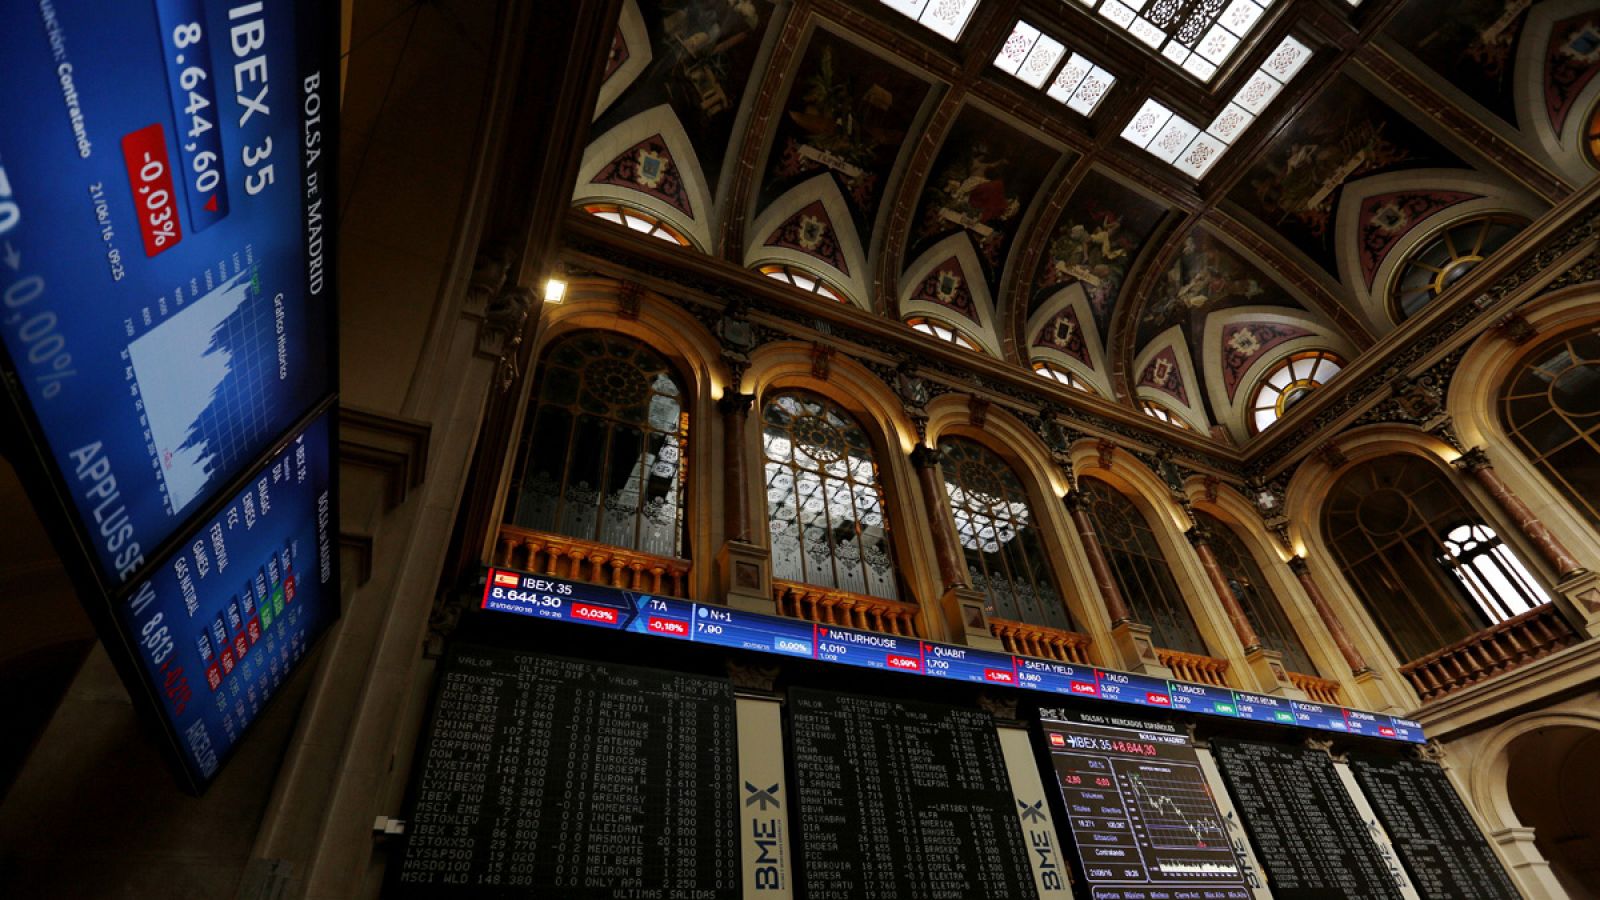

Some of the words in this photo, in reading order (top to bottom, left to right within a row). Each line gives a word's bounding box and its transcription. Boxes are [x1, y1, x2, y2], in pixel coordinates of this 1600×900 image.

[228, 1, 270, 129] IBEX
[57, 62, 92, 159] Contratando
[173, 21, 220, 193] 8.644,60
[303, 71, 321, 168] BOLSA
[242, 135, 275, 196] 35
[306, 171, 319, 199] DE
[140, 152, 176, 247] -0,03%
[89, 182, 112, 241] 21/06/16
[107, 248, 126, 282] 09:25
[307, 198, 323, 295] MADRID
[273, 292, 285, 335] Gráfico
[3, 274, 77, 400] 0,00%
[276, 334, 289, 381] Histórico
[271, 463, 283, 484] DIA
[257, 476, 272, 517] ENAGAS
[241, 490, 257, 531] ENDESA
[226, 506, 240, 531] FCC
[68, 439, 134, 556] APPLUS
[140, 610, 174, 665] 8,613
[208, 521, 230, 575] FERROVIAL
[191, 538, 210, 580] GAMESA
[173, 555, 189, 581] GAS
[522, 577, 554, 592] IBEX
[556, 583, 573, 595] 35
[179, 573, 200, 618] NATURAL
[492, 587, 561, 608] 8.644,30
[649, 599, 668, 612] TA
[575, 607, 613, 621] -0,03%
[710, 609, 733, 622] N+1
[650, 622, 684, 633] -0,18%
[779, 640, 807, 652] 0,00%
[829, 630, 897, 649] NATURHOUSE
[933, 646, 966, 660] QUABIT
[458, 656, 493, 667] VALOR
[514, 655, 592, 673] COTIZACIONES
[1025, 660, 1050, 673] SAETA
[1051, 664, 1074, 676] YIELD
[519, 664, 559, 677] ULTIMO
[564, 670, 584, 680] DIF
[1104, 672, 1129, 685] TALGO
[447, 672, 503, 687] ESTOXX50
[608, 675, 639, 687] VALOR
[446, 682, 473, 692] IBEX
[481, 686, 496, 695] 35
[601, 691, 645, 704] INKEMIA
[599, 700, 649, 713] AB-BIOTI
[438, 710, 497, 723] LYXIBEX2
[599, 709, 632, 720] ALTIA
[1039, 707, 1058, 718] BME
[1080, 713, 1105, 724] BOLSAS
[1111, 717, 1142, 729] MERCADOS
[1143, 721, 1176, 732] ESPAÑOLES
[436, 719, 473, 732] CHINA
[480, 723, 495, 734] HS
[598, 717, 649, 729] BIONATUR
[597, 726, 649, 740] CARBURES
[431, 738, 492, 752] CORPBOND
[1073, 735, 1099, 749] IBEX
[1099, 740, 1112, 751] 35
[1118, 742, 1157, 756] 8.644,30
[429, 748, 453, 759] DOW
[460, 751, 468, 760] J
[476, 752, 490, 763] IA
[595, 753, 648, 766] EUROCONS
[426, 759, 488, 772] LYXETFMT
[595, 763, 648, 776] EUROESPE
[593, 772, 634, 784] EURONA
[421, 779, 485, 793] LYXIBEXM
[420, 790, 452, 801] IBEX
[591, 791, 646, 804] GRENERGY
[416, 801, 448, 812] MSCI
[456, 803, 480, 814] EME
[591, 801, 645, 814] HOMEMEAL
[415, 812, 480, 825] ESTOXLEW
[591, 811, 632, 823] INCLAM
[413, 823, 445, 835] IBEX
[453, 825, 469, 836] 35
[589, 822, 645, 834] LLEIDANT
[803, 823, 821, 832] DIA
[408, 835, 475, 848] ESTOXX50
[588, 832, 644, 845] MASMOVIL
[586, 855, 607, 865] NBI
[615, 855, 644, 866] BEAR
[752, 818, 779, 890] BME
[804, 851, 823, 860] FCC
[1029, 829, 1062, 891] BME
[403, 858, 471, 871] NASDQ100
[585, 865, 629, 877] NEURON
[805, 860, 852, 871] FERROVIA
[400, 871, 433, 883] MSCI
[443, 872, 469, 884] WLD
[584, 876, 615, 888] ONLY
[620, 877, 643, 888] APA
[806, 871, 841, 881] GAMESA
[807, 880, 825, 889] GAS
[612, 888, 663, 900] ULTIMAS
[669, 888, 717, 900] SALIDAS
[807, 890, 849, 900] GRIFOLS
